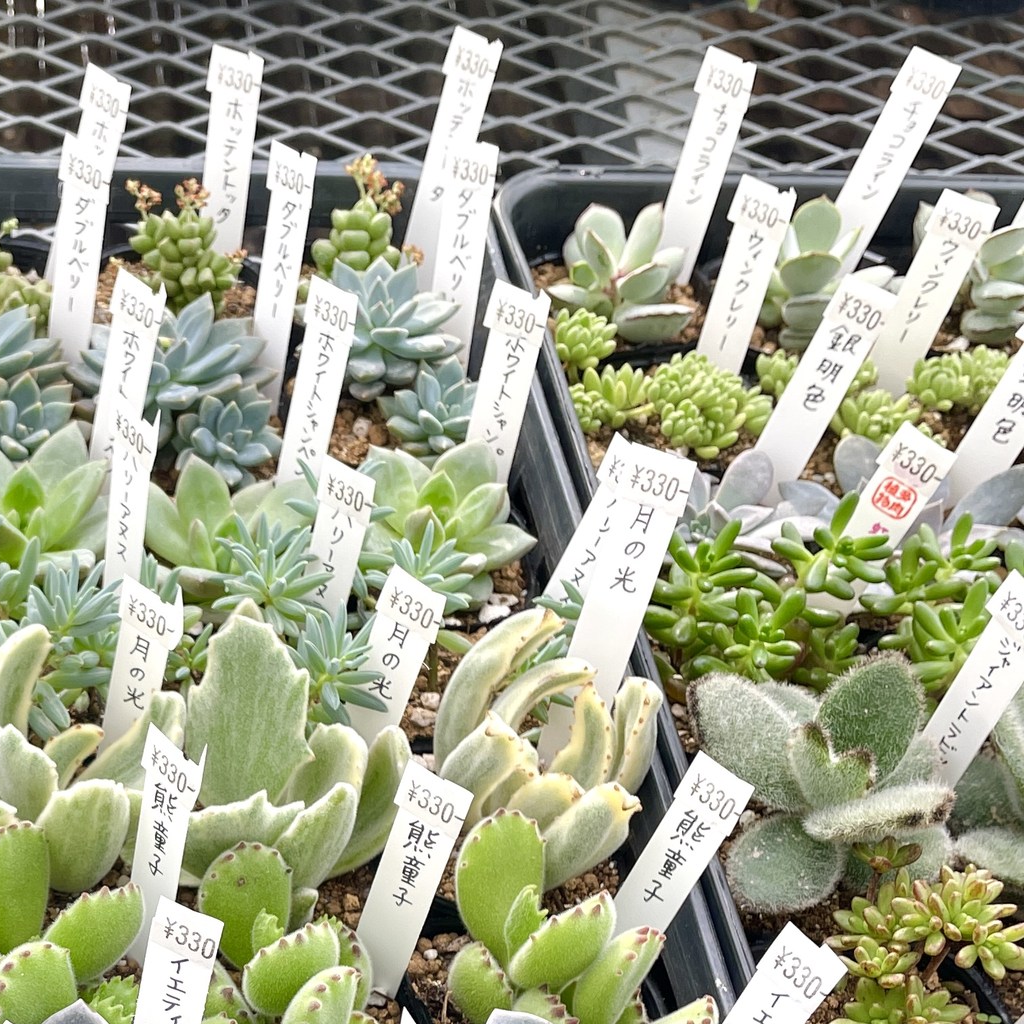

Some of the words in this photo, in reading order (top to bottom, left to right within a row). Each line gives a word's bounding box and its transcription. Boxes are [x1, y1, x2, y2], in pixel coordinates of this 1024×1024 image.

[630, 464, 689, 501] ¥330-
[609, 503, 655, 594] 月の光
[123, 635, 152, 710] 月の光
[392, 820, 441, 907] 熊童子
[643, 809, 711, 903] 熊童子
